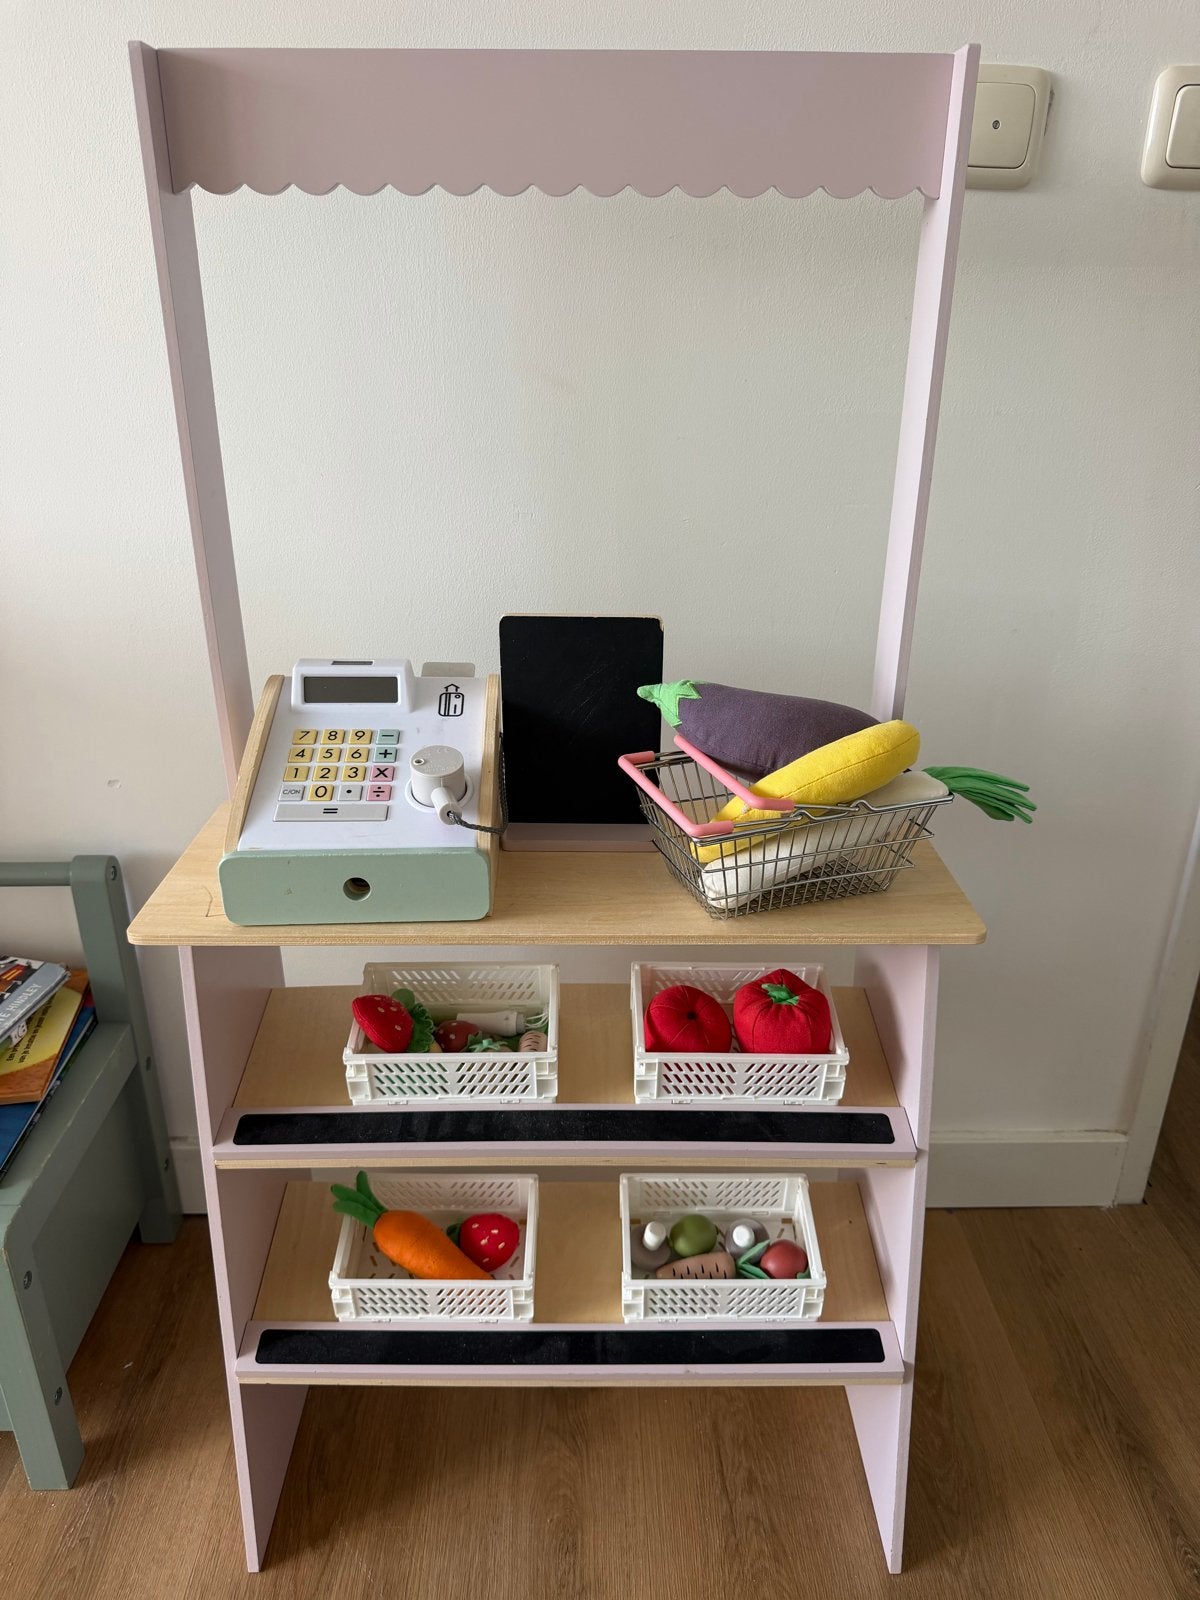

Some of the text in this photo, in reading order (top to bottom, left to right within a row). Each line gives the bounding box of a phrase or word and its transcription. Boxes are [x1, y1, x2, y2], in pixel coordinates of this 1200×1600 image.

[299, 730, 310, 740] 7
[327, 730, 338, 741] 8
[355, 730, 365, 740] 9
[295, 748, 305, 758] 4
[323, 748, 333, 758] 5
[351, 748, 362, 759] 6
[293, 767, 299, 778] 1
[319, 767, 331, 778] 2
[347, 766, 358, 778] 3
[315, 785, 328, 798] 0
